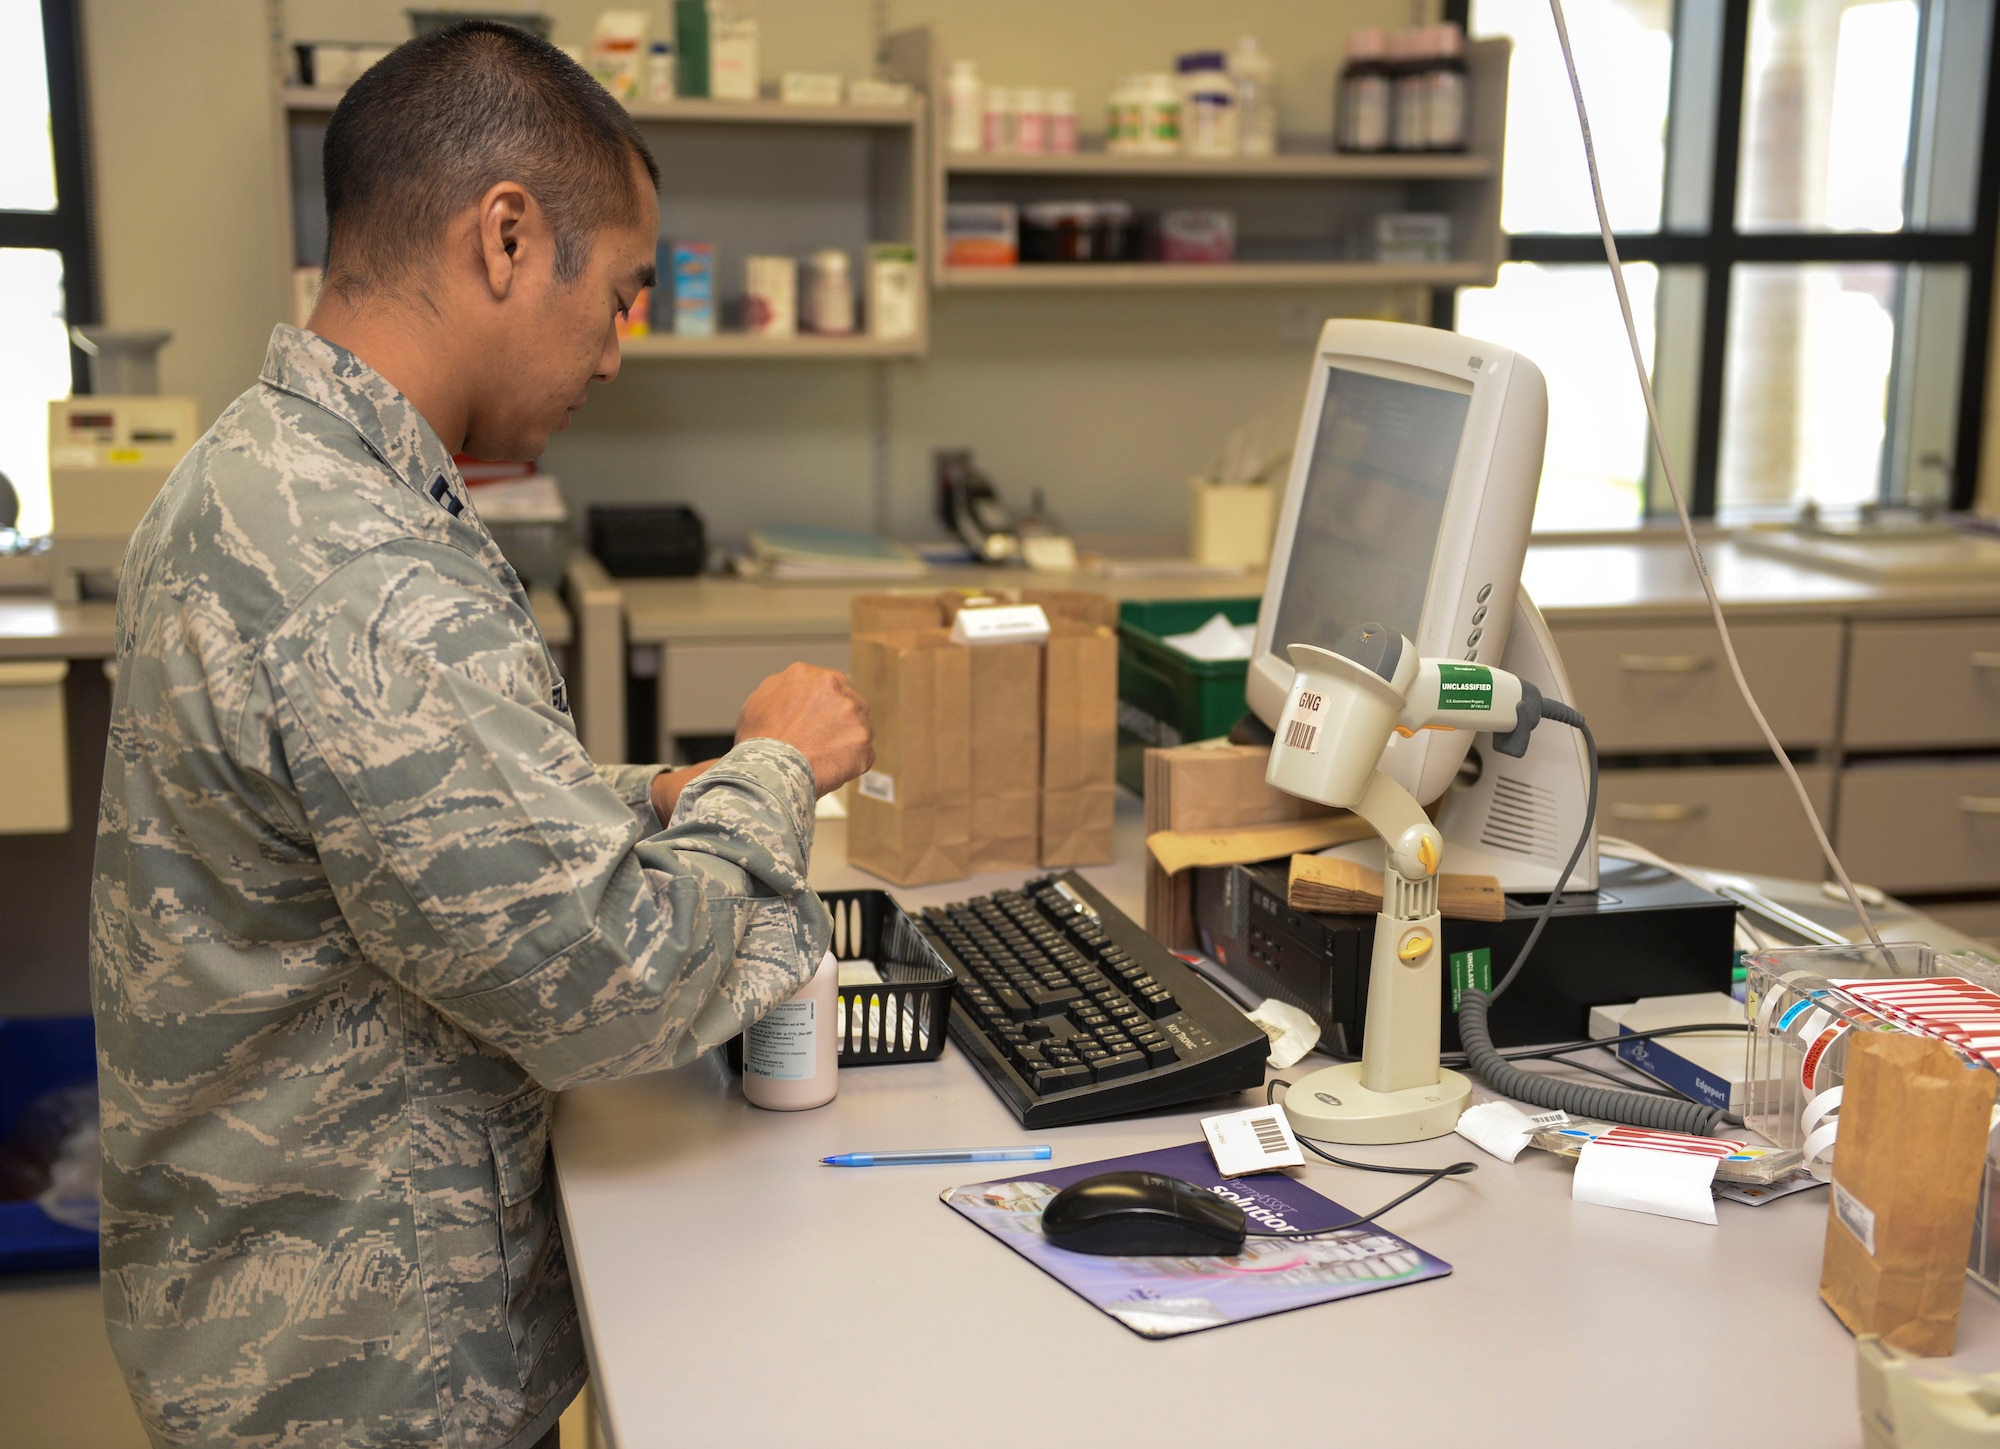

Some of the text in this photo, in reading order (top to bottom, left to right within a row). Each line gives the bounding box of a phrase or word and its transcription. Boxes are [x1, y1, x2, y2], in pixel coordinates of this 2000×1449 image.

[1441, 683, 1491, 691] UNCLASSIFIED
[1299, 692, 1322, 712] GNG
[1467, 952, 1475, 989] UNCLASS
[1695, 1077, 1725, 1102] Edgeport
